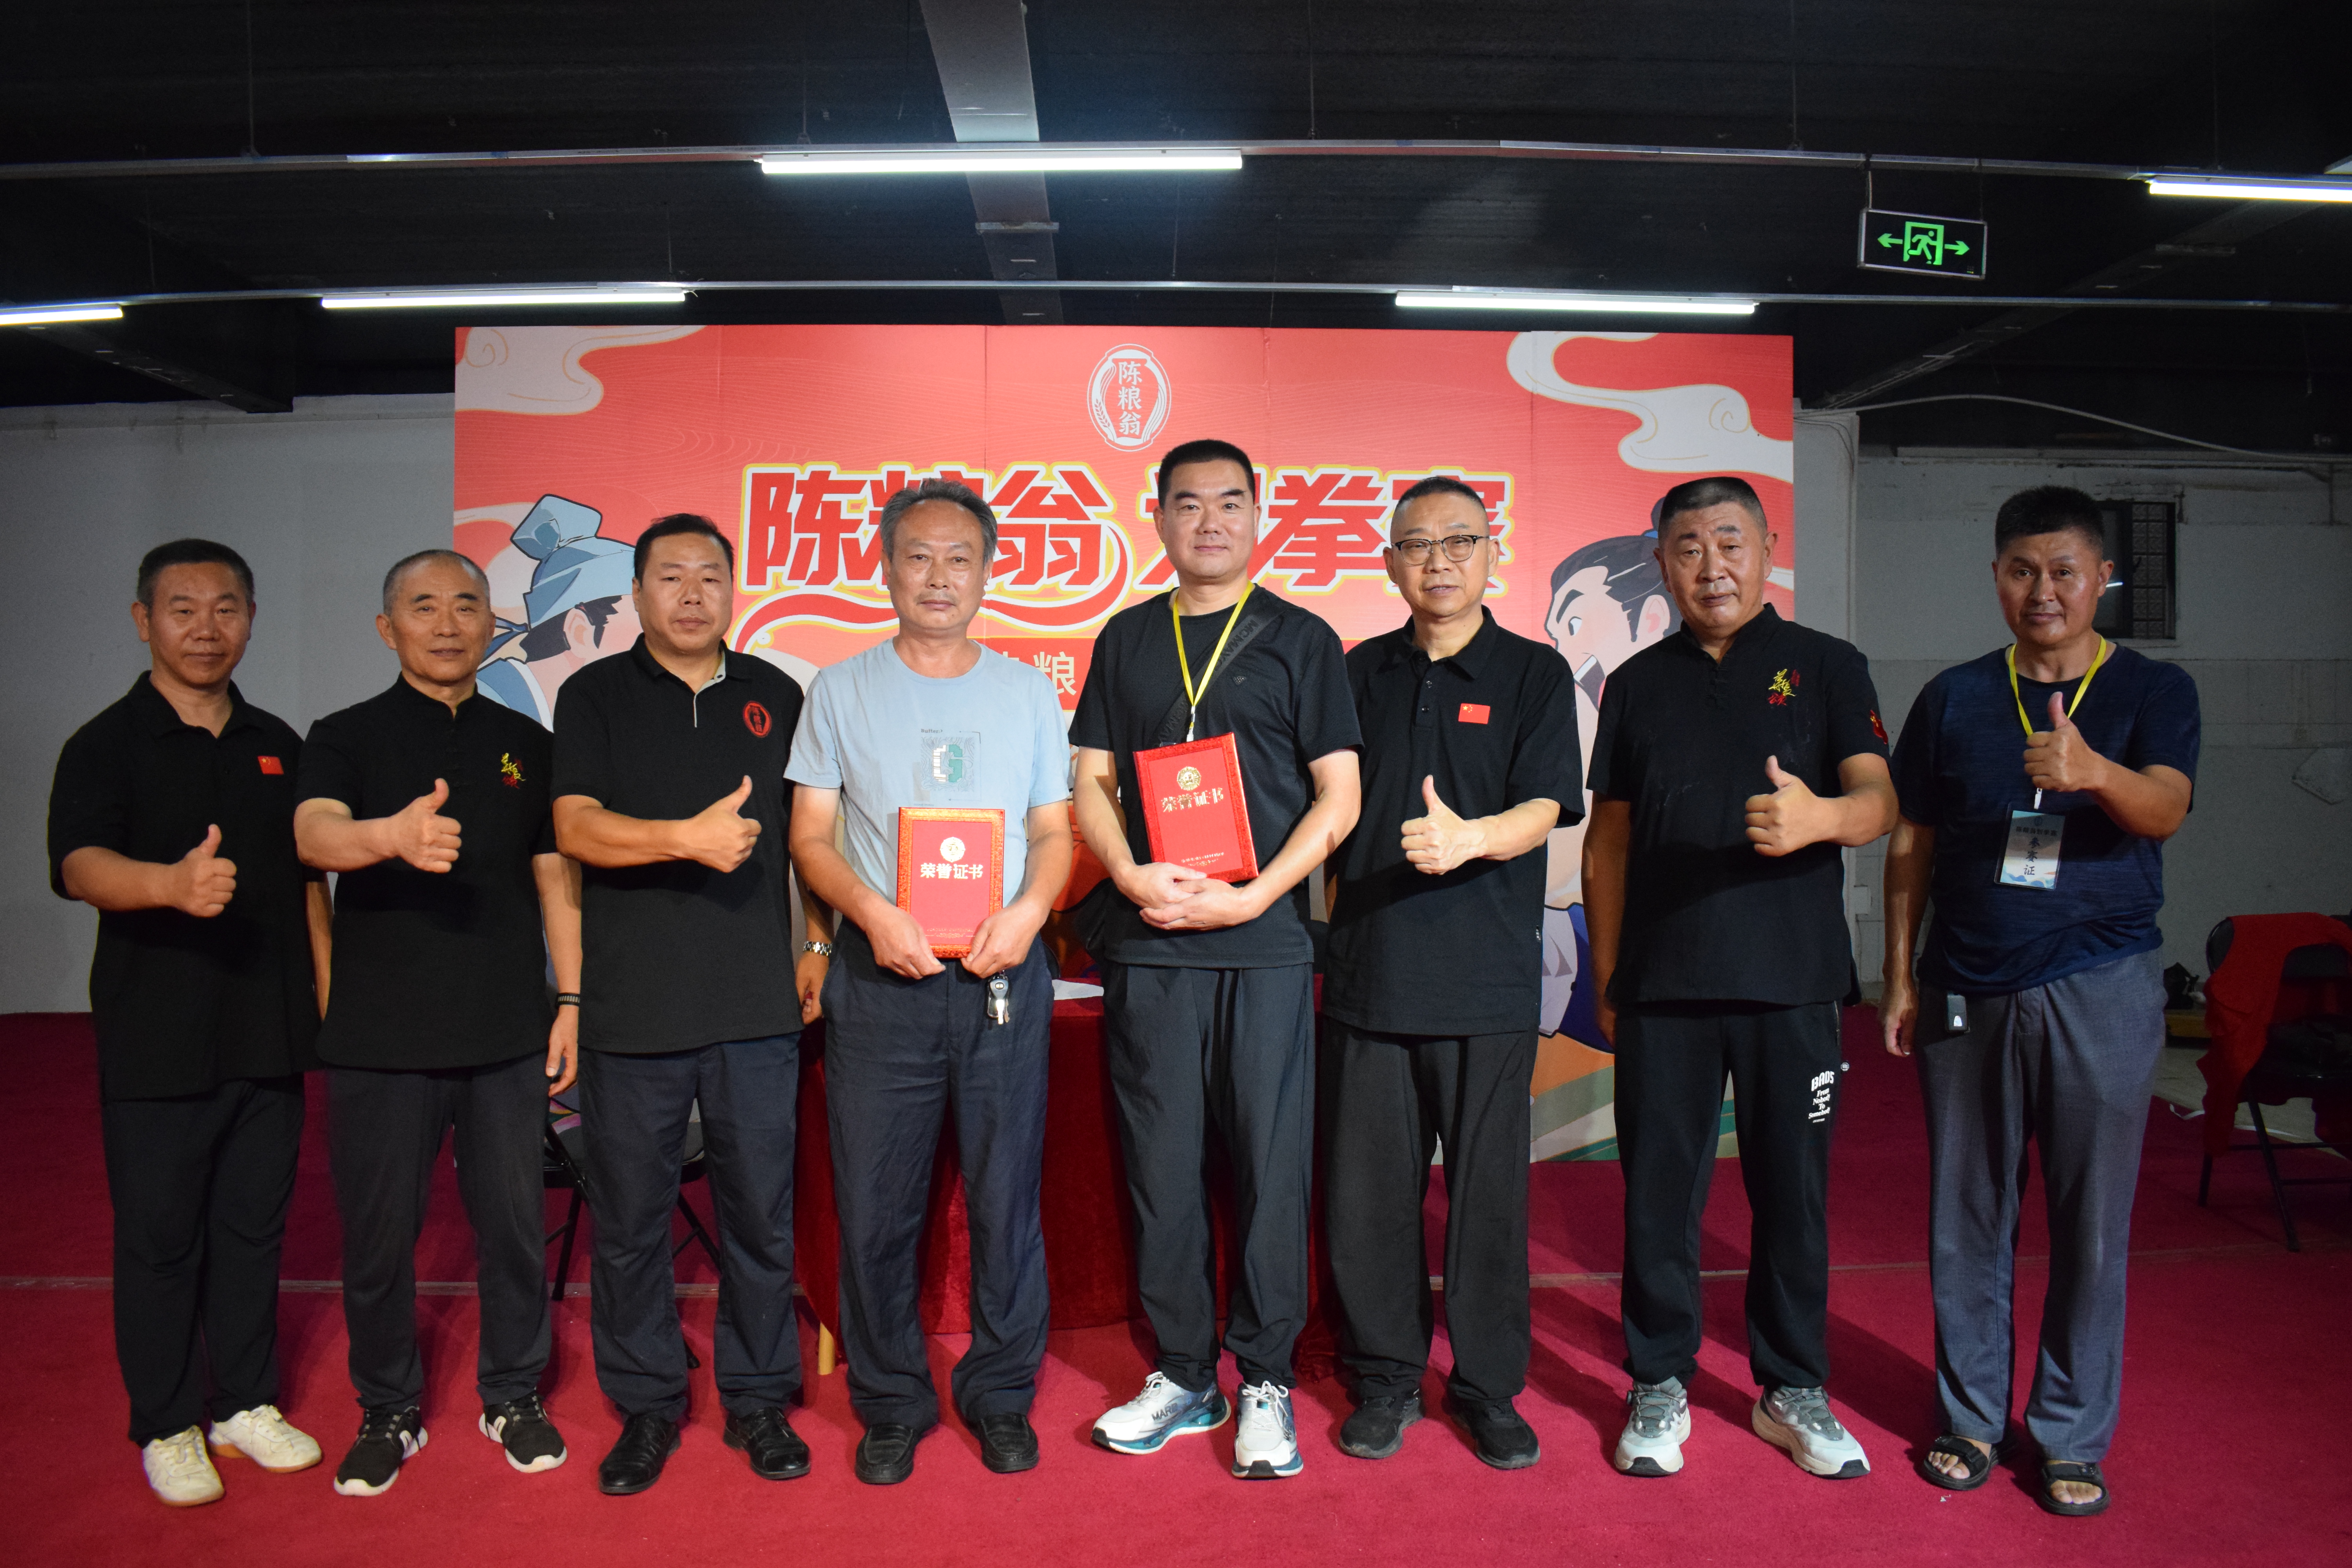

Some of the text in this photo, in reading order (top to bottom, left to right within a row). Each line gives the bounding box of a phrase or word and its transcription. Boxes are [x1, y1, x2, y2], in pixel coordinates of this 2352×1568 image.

[1118, 361, 1142, 436] 陈粮翁
[745, 467, 1109, 587] 陈翁
[1161, 788, 1224, 813] 荣誉证书
[2023, 837, 2040, 876] 参赛证
[920, 863, 983, 879] 荣誉证书
[1811, 1071, 1835, 1091] BADS
[1812, 1094, 1831, 1105] Nobody
[1817, 1088, 1829, 1097] From
[1808, 1107, 1831, 1119] Somebody
